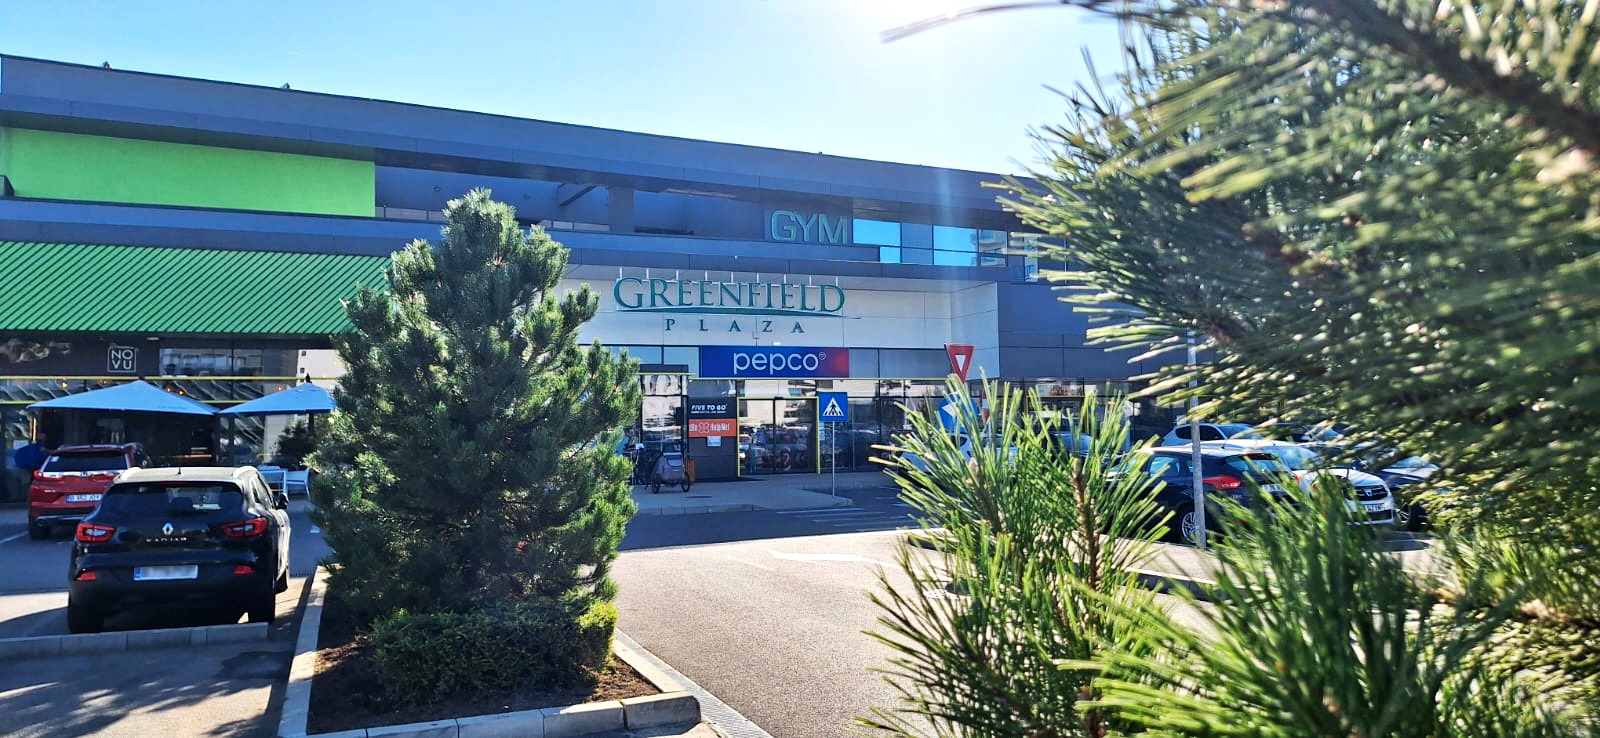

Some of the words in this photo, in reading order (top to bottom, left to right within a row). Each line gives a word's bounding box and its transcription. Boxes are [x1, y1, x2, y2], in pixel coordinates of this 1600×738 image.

[771, 209, 848, 245] GYM
[613, 277, 846, 313] GREENFIELD
[664, 318, 805, 334] PLAZA
[111, 349, 134, 360] NO
[111, 359, 133, 370] VU
